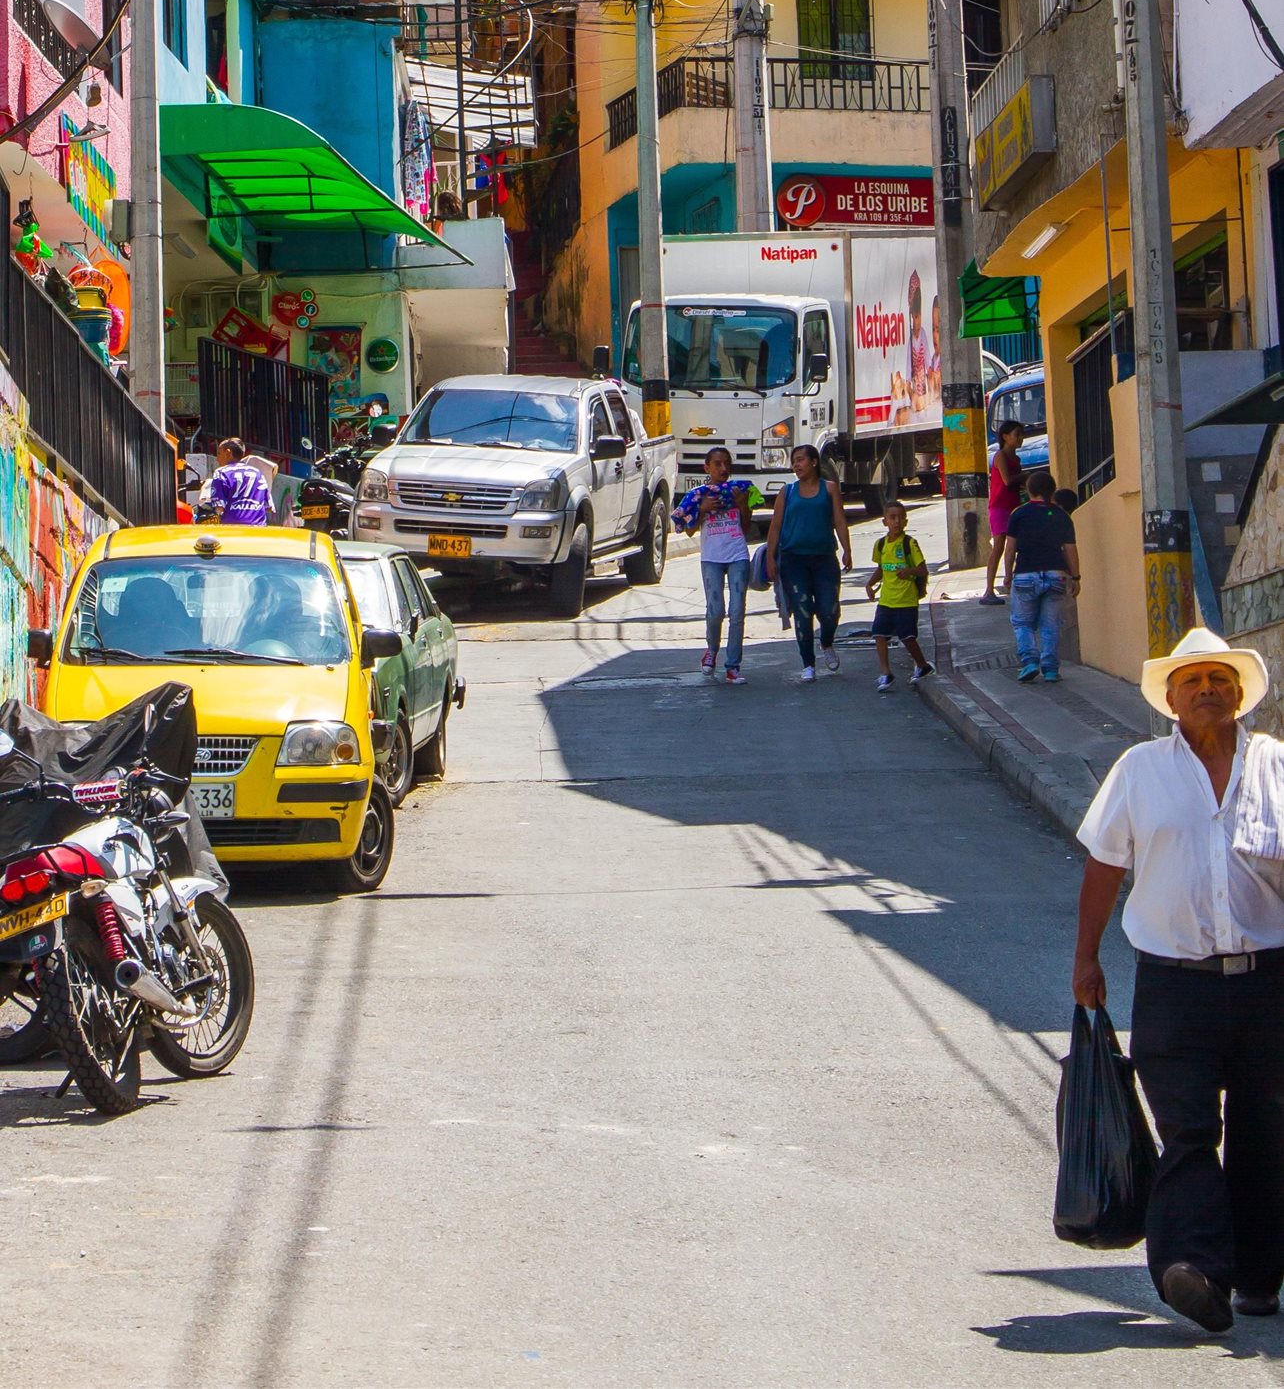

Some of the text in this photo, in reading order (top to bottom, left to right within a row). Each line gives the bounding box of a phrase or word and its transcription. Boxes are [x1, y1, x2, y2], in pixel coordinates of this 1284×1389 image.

[854, 182, 910, 195] LA ESQUINA
[837, 195, 928, 213] DE LOS URIBE
[854, 212, 868, 221] KRA
[870, 213, 882, 221] 109
[889, 213, 913, 222] 35F-41
[761, 245, 817, 263] Natipan
[856, 301, 906, 359] Natipan
[232, 471, 257, 498] 17
